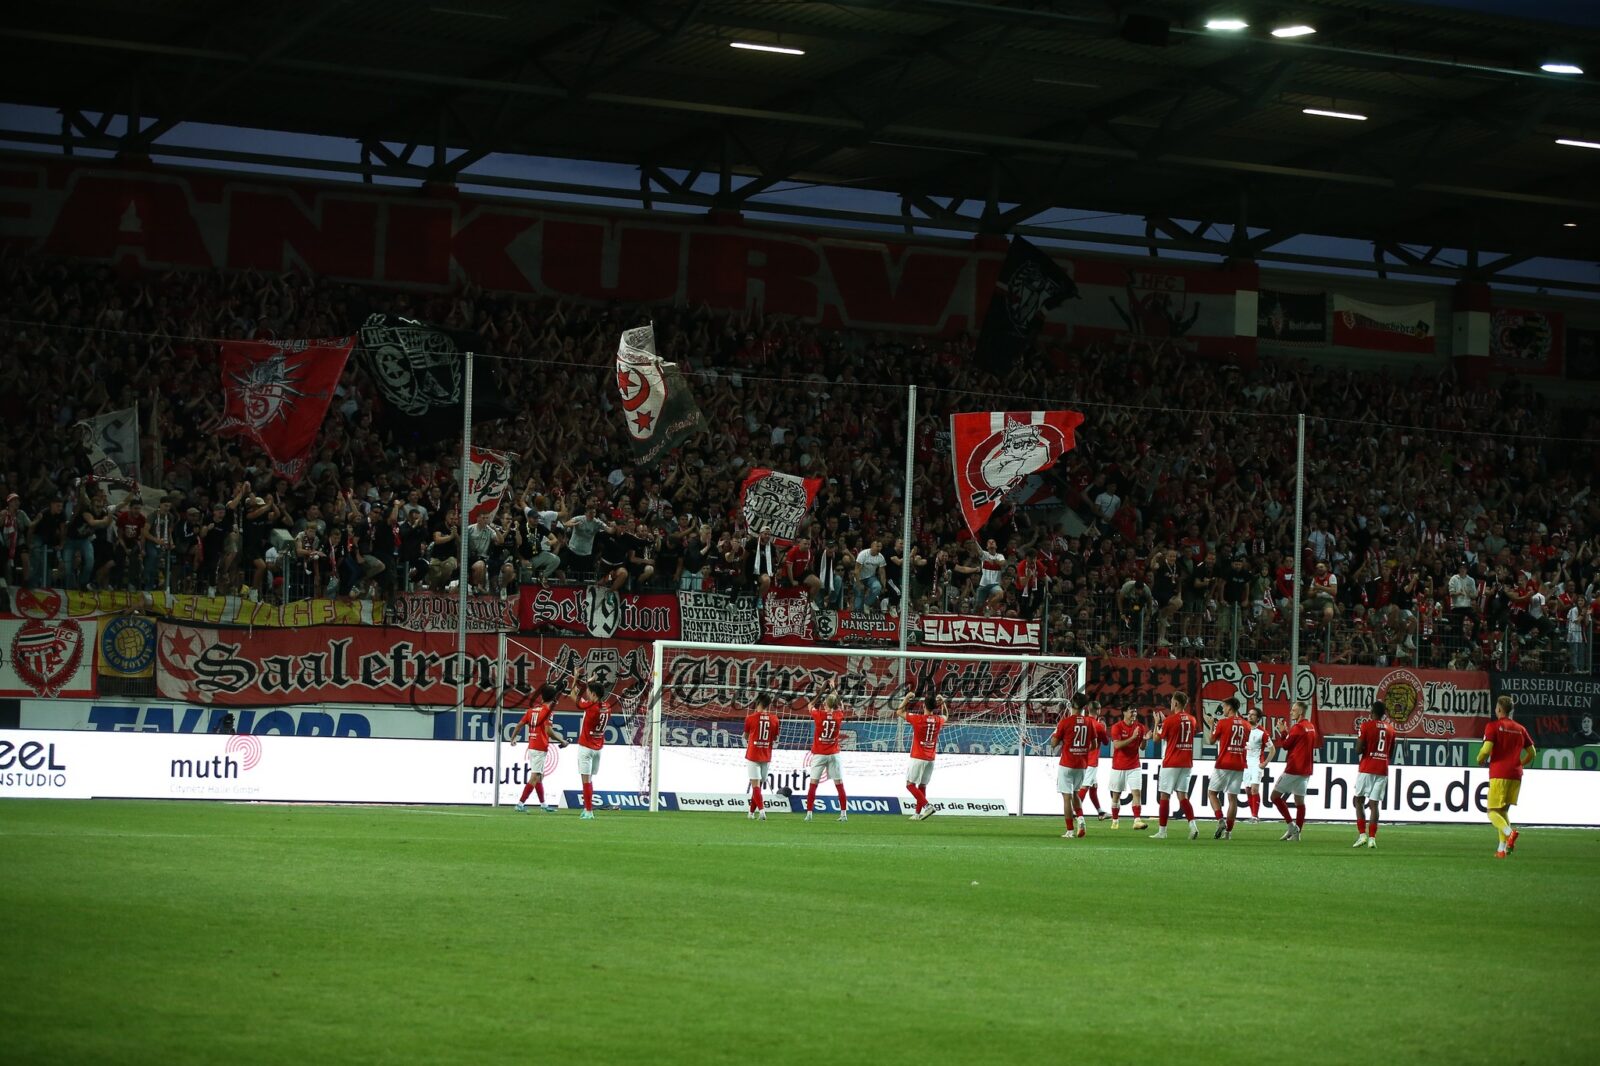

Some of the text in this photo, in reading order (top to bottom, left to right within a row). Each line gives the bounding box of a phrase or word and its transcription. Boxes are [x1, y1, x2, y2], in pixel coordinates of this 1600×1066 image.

[0, 168, 1074, 344] ANKURV
[841, 620, 896, 631] MANSFELD
[923, 620, 1040, 644] SURREALE
[592, 651, 615, 661] HFC
[193, 636, 535, 696] Saalefront
[1202, 664, 1236, 683] HFC
[1317, 677, 1489, 714] Leuna Löwen
[1501, 678, 1600, 695] MERSEBURGER
[1510, 693, 1592, 708] DOMFALKEN
[759, 720, 770, 740] 16
[821, 720, 836, 738] 37
[1074, 725, 1088, 746] 20
[1181, 721, 1191, 743] 17
[1230, 725, 1244, 746] 29
[1422, 717, 1456, 736] 1984
[1378, 729, 1386, 752] 6
[1312, 741, 1463, 766] AUTATION
[171, 756, 238, 779] muth
[607, 792, 668, 808] UNION
[681, 796, 725, 808] bewegt
[727, 797, 745, 807] die
[832, 799, 890, 812] UNION
[903, 801, 1007, 813] begt die Region
